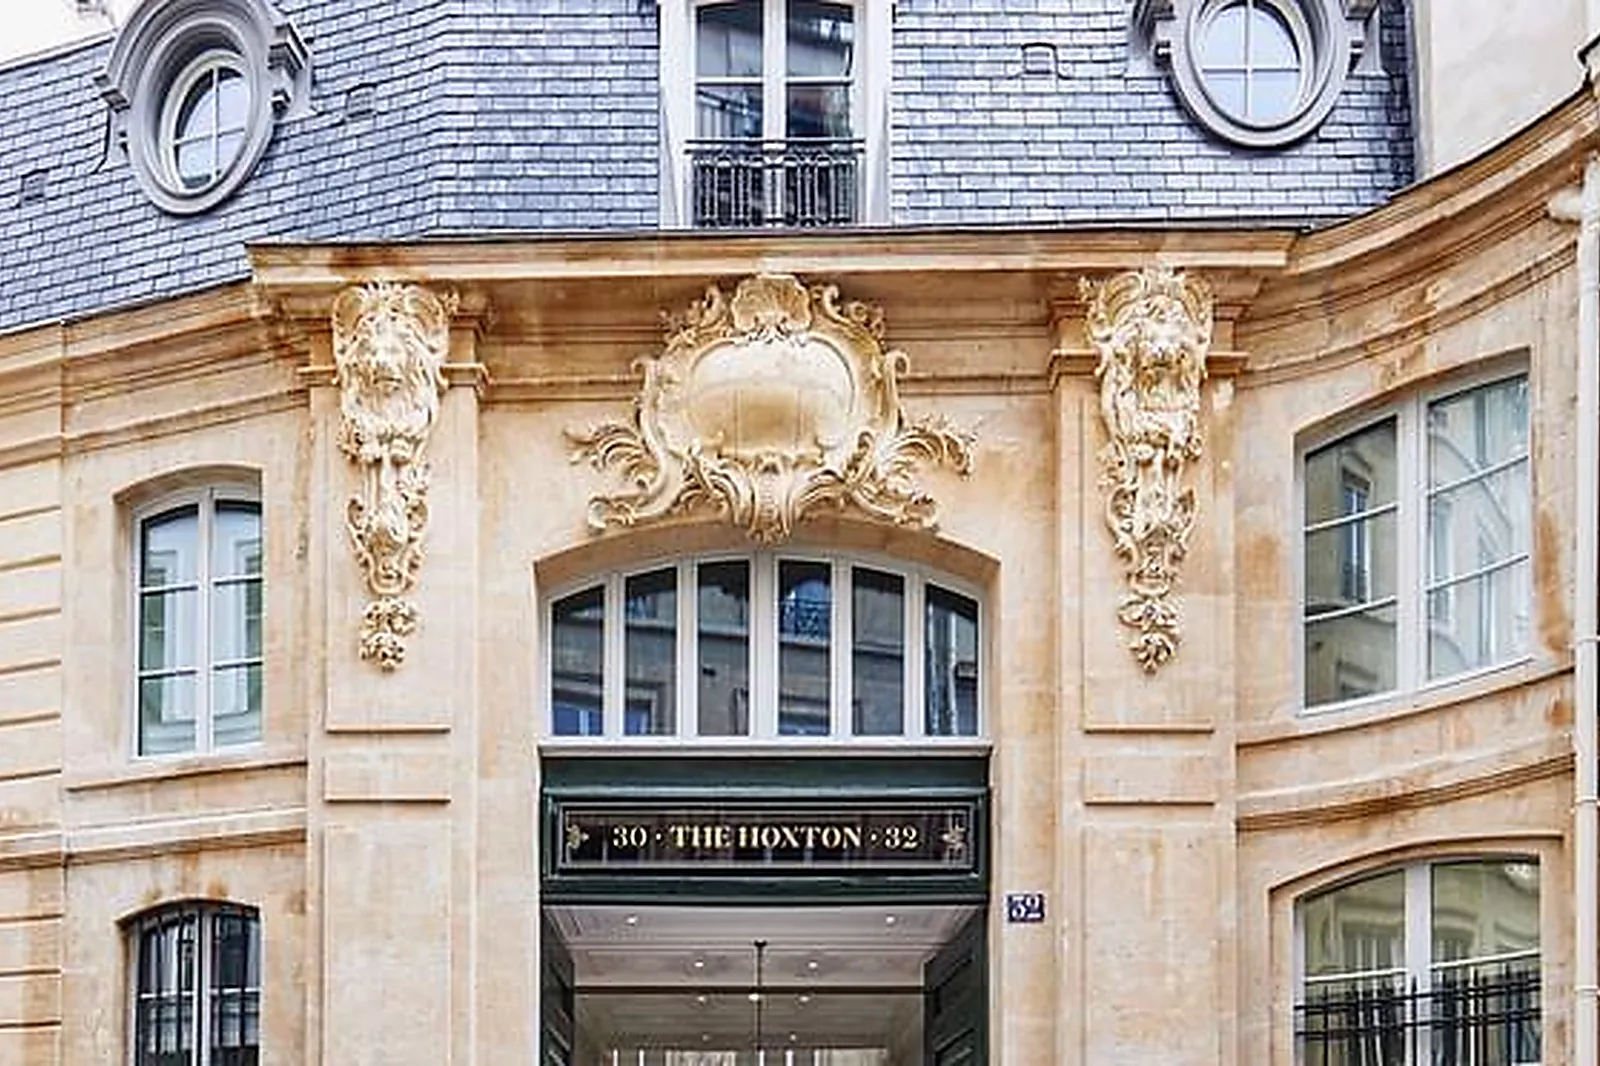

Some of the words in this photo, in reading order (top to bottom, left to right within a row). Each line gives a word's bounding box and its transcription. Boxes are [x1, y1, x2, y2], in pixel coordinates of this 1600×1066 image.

[612, 827, 648, 849] 30
[669, 827, 731, 848] THE
[738, 826, 862, 848] HOXTON
[884, 827, 918, 849] 32
